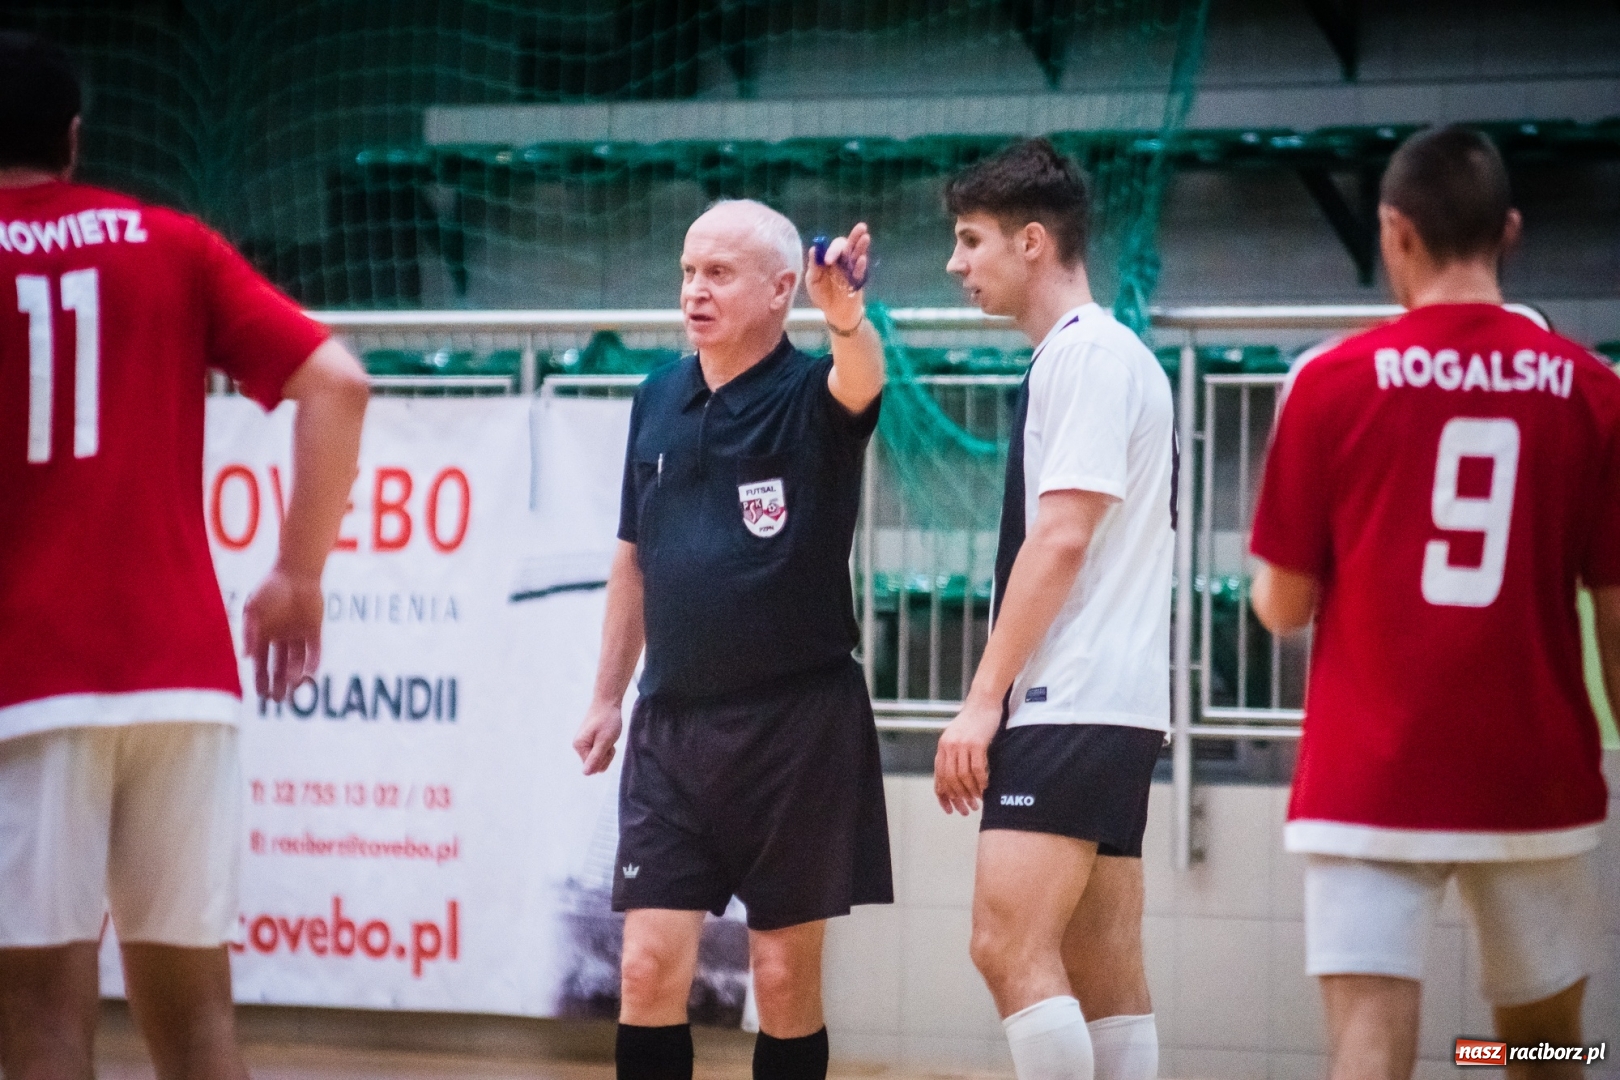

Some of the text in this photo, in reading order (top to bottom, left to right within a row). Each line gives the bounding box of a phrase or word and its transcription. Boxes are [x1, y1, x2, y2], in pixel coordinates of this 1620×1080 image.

[15, 268, 99, 465] 11
[1373, 345, 1575, 399] ROGALSKI
[746, 485, 777, 496] FUTSAL
[1421, 416, 1521, 608] 9
[326, 591, 459, 623] DNIENIA
[1000, 795, 1035, 807] JAKO
